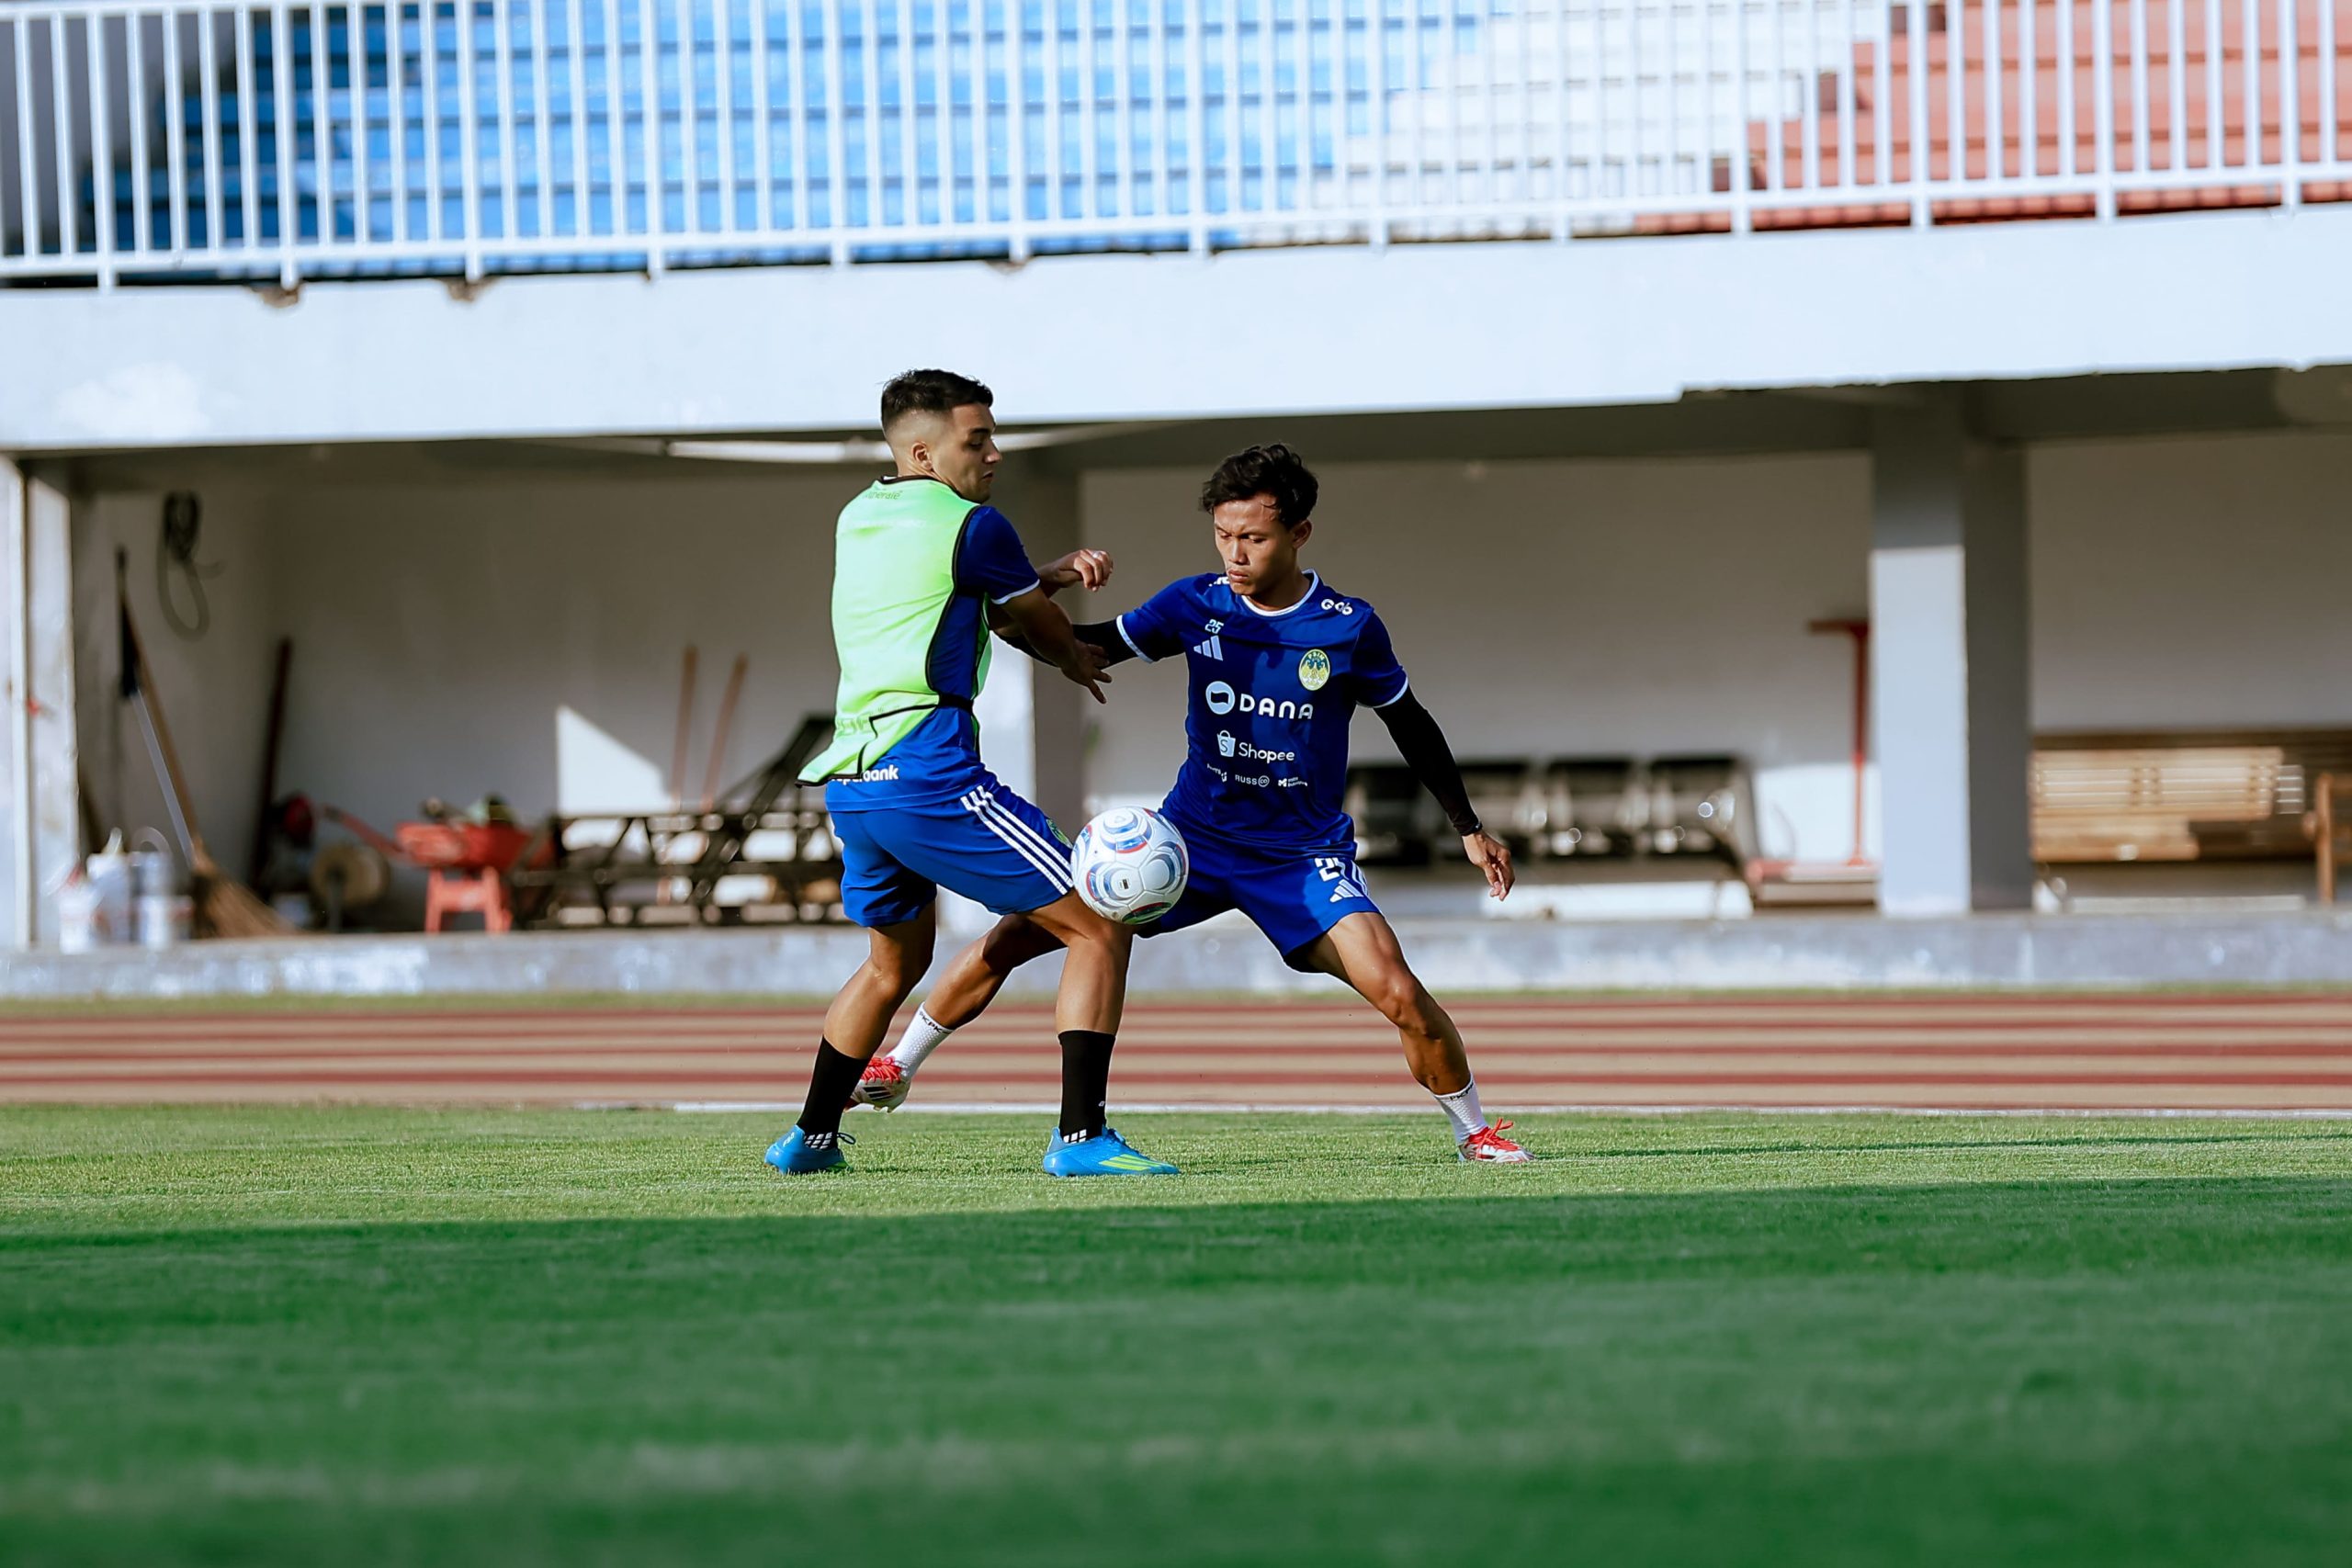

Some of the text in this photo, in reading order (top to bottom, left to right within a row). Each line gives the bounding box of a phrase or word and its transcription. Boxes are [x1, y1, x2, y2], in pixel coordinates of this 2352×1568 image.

[1204, 618, 1224, 634] 25
[1239, 693, 1314, 719] DANA
[1238, 742, 1295, 763] Shopee
